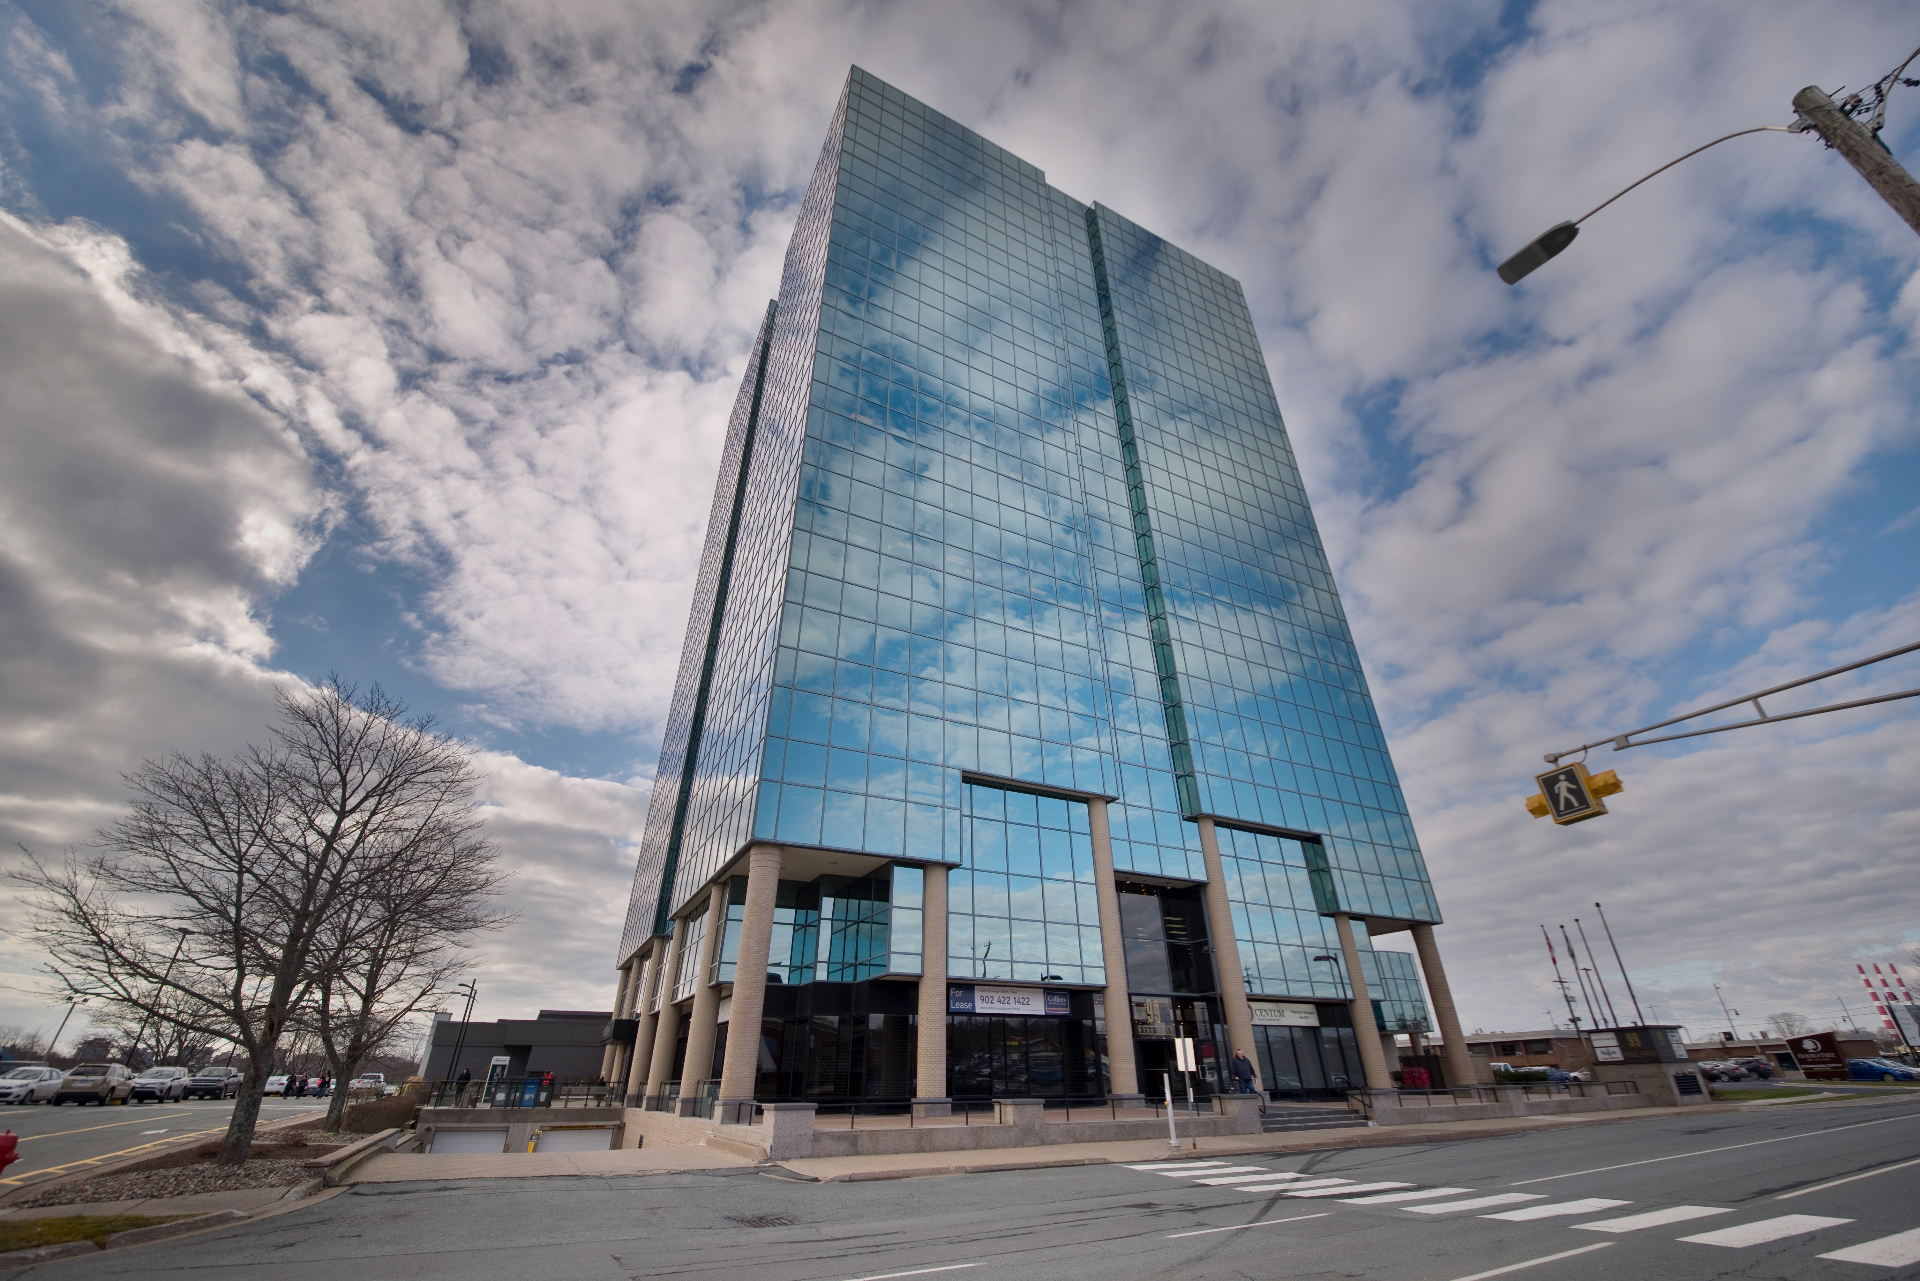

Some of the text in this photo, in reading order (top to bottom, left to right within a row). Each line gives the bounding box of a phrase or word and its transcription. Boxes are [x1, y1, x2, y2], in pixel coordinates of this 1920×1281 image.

[950, 988, 964, 997] For
[979, 995, 1031, 1006] 902 422 1422
[1047, 994, 1067, 1003] Colliers
[950, 999, 973, 1010] Lease
[1145, 998, 1161, 1023] 99
[1254, 1008, 1285, 1018] CENTUM
[1625, 1032, 1642, 1048] 99
